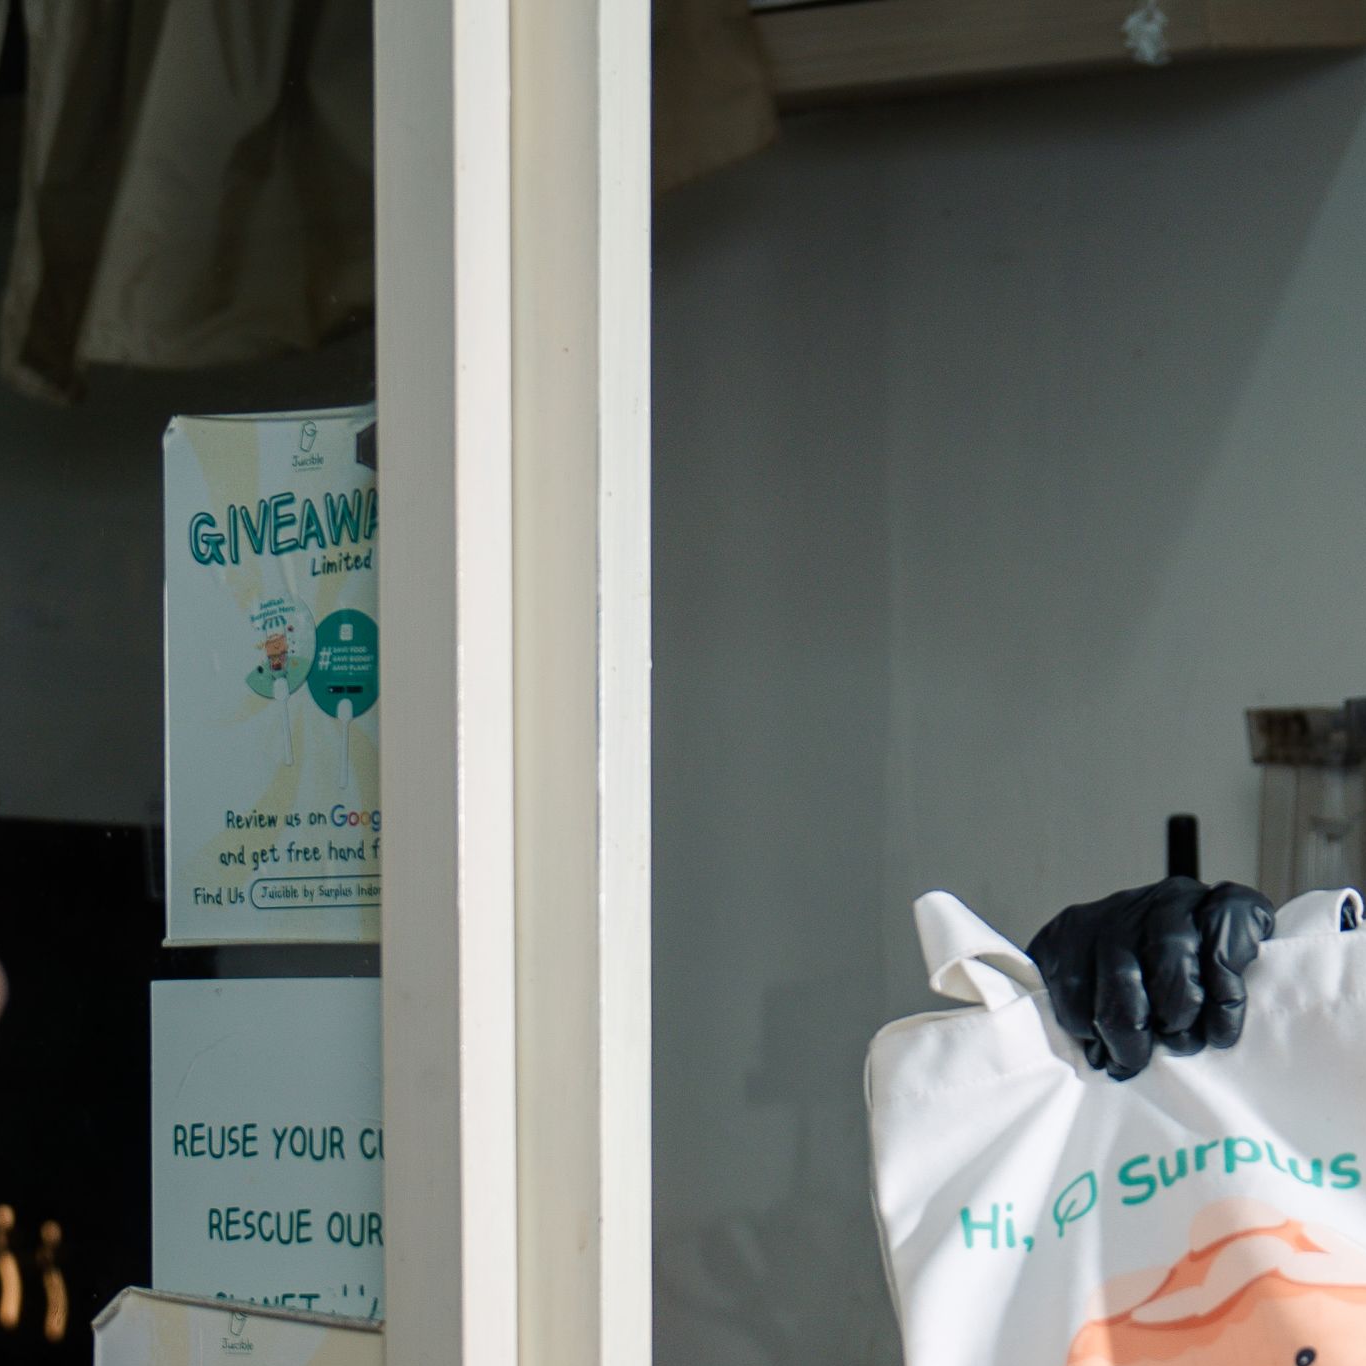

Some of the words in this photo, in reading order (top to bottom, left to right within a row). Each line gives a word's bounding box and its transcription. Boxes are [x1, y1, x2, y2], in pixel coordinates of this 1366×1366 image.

[291, 452, 324, 467] Juicible
[311, 548, 372, 577] Limited
[226, 809, 278, 829] Review
[286, 812, 301, 828] us
[309, 811, 327, 825] on
[220, 845, 246, 866] and
[252, 844, 280, 871] get
[287, 840, 321, 862] free
[329, 840, 365, 861] hand
[193, 887, 223, 905] Find
[228, 887, 245, 905] Us
[260, 885, 299, 899] Juicible
[303, 885, 315, 901] by
[319, 883, 353, 900] Surplus
[173, 1123, 258, 1159] REUSE
[272, 1125, 345, 1161] YOUR
[960, 1202, 1035, 1253] Hi,
[1117, 1135, 1362, 1207] Surplus
[208, 1207, 313, 1245] RESCUE
[327, 1211, 384, 1247] OUR
